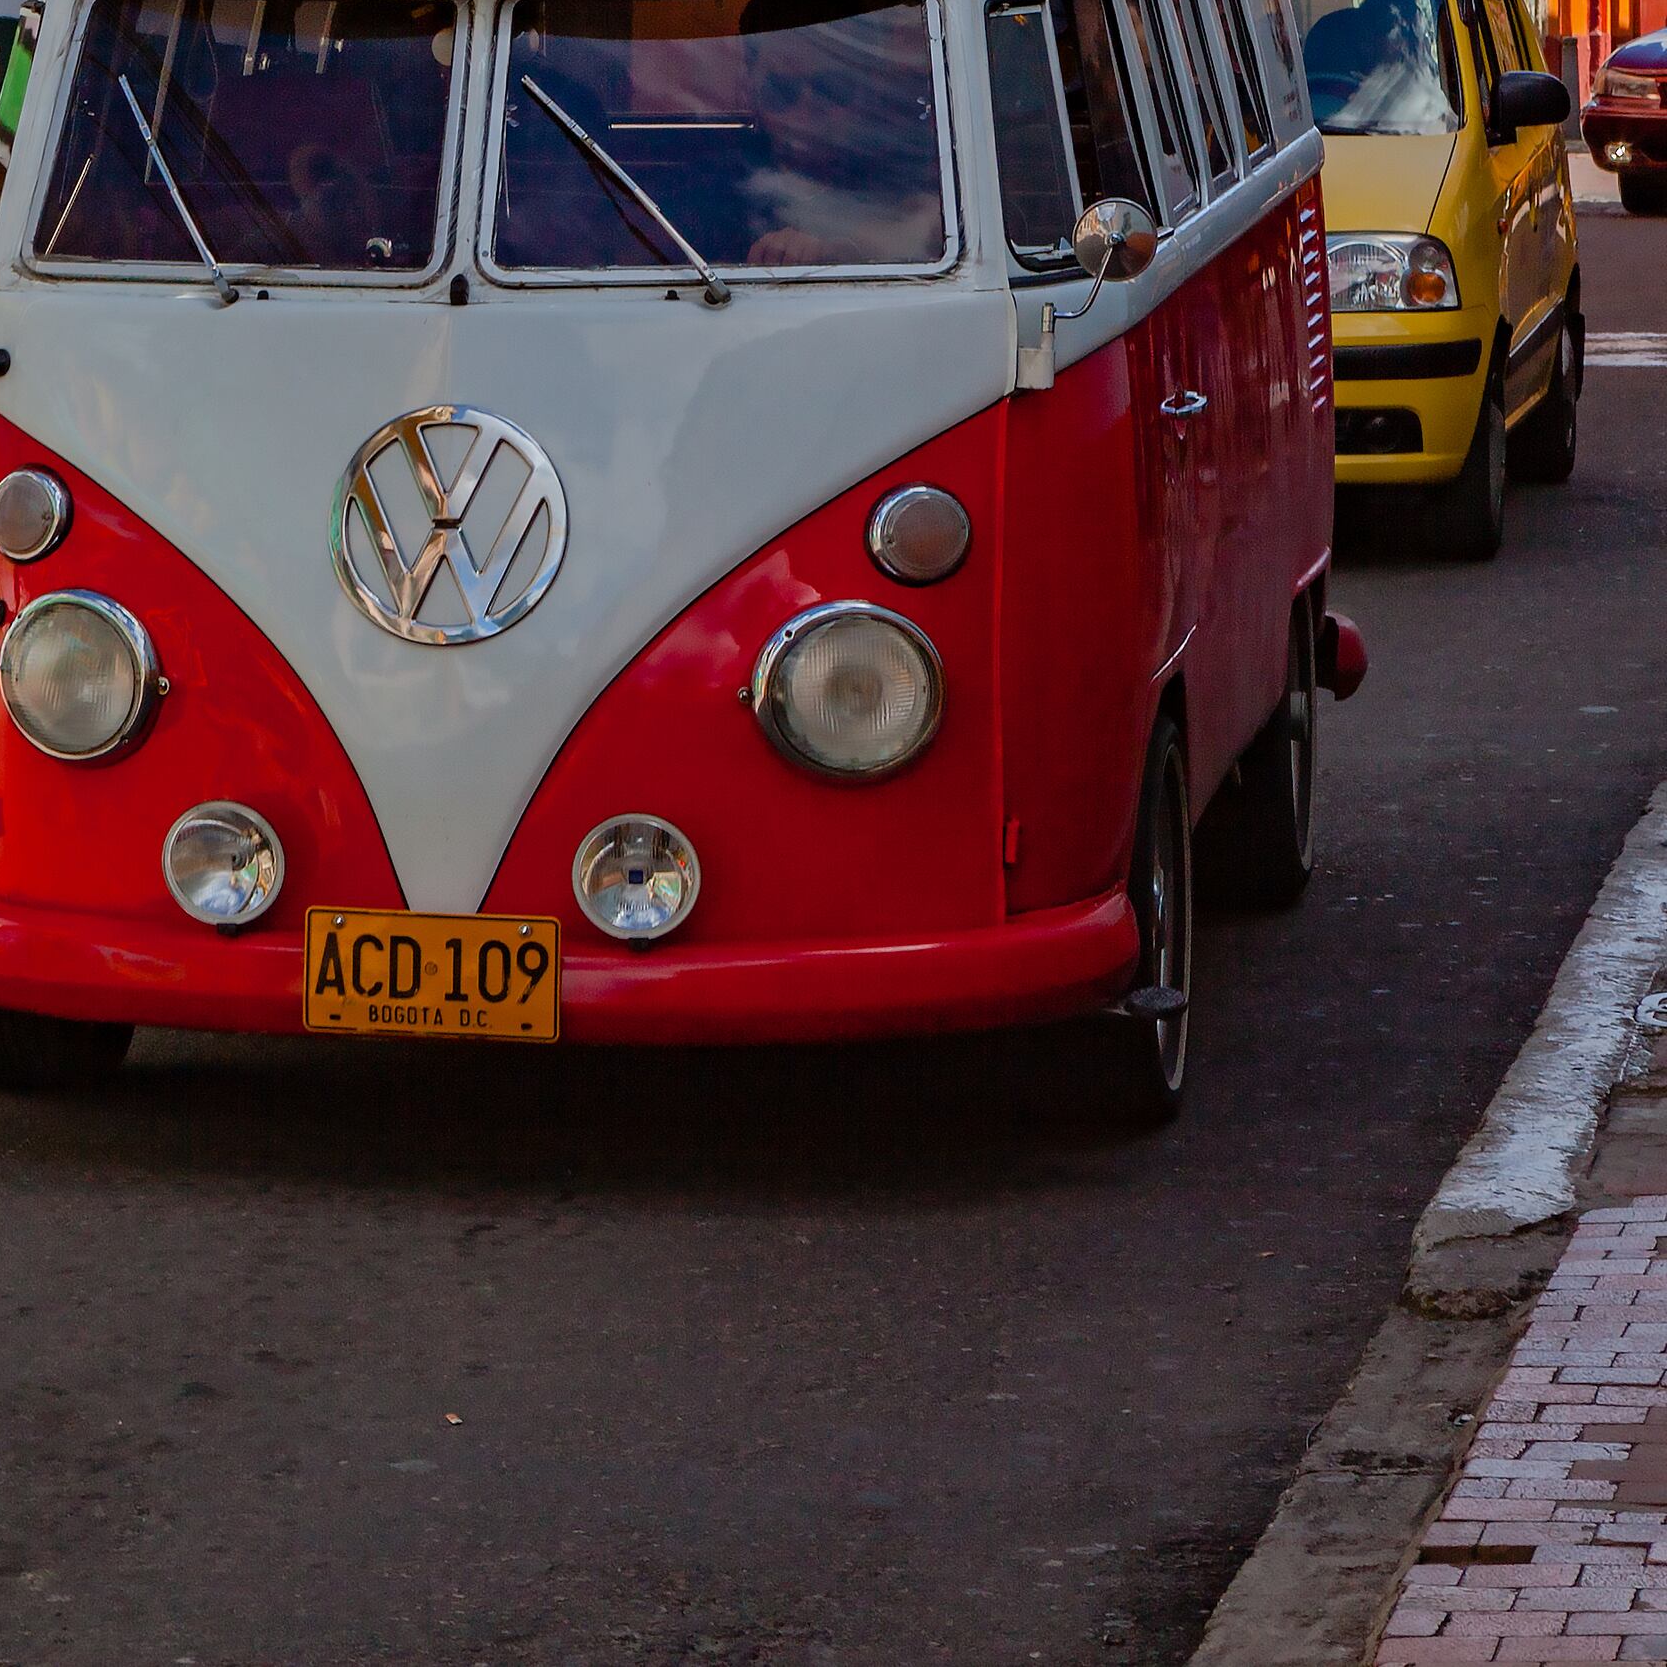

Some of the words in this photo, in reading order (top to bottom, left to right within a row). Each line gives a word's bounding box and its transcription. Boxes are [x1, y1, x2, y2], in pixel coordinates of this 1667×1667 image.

[315, 932, 421, 999] ACD
[444, 938, 549, 1004] 109
[368, 1004, 444, 1026] BOGOTA
